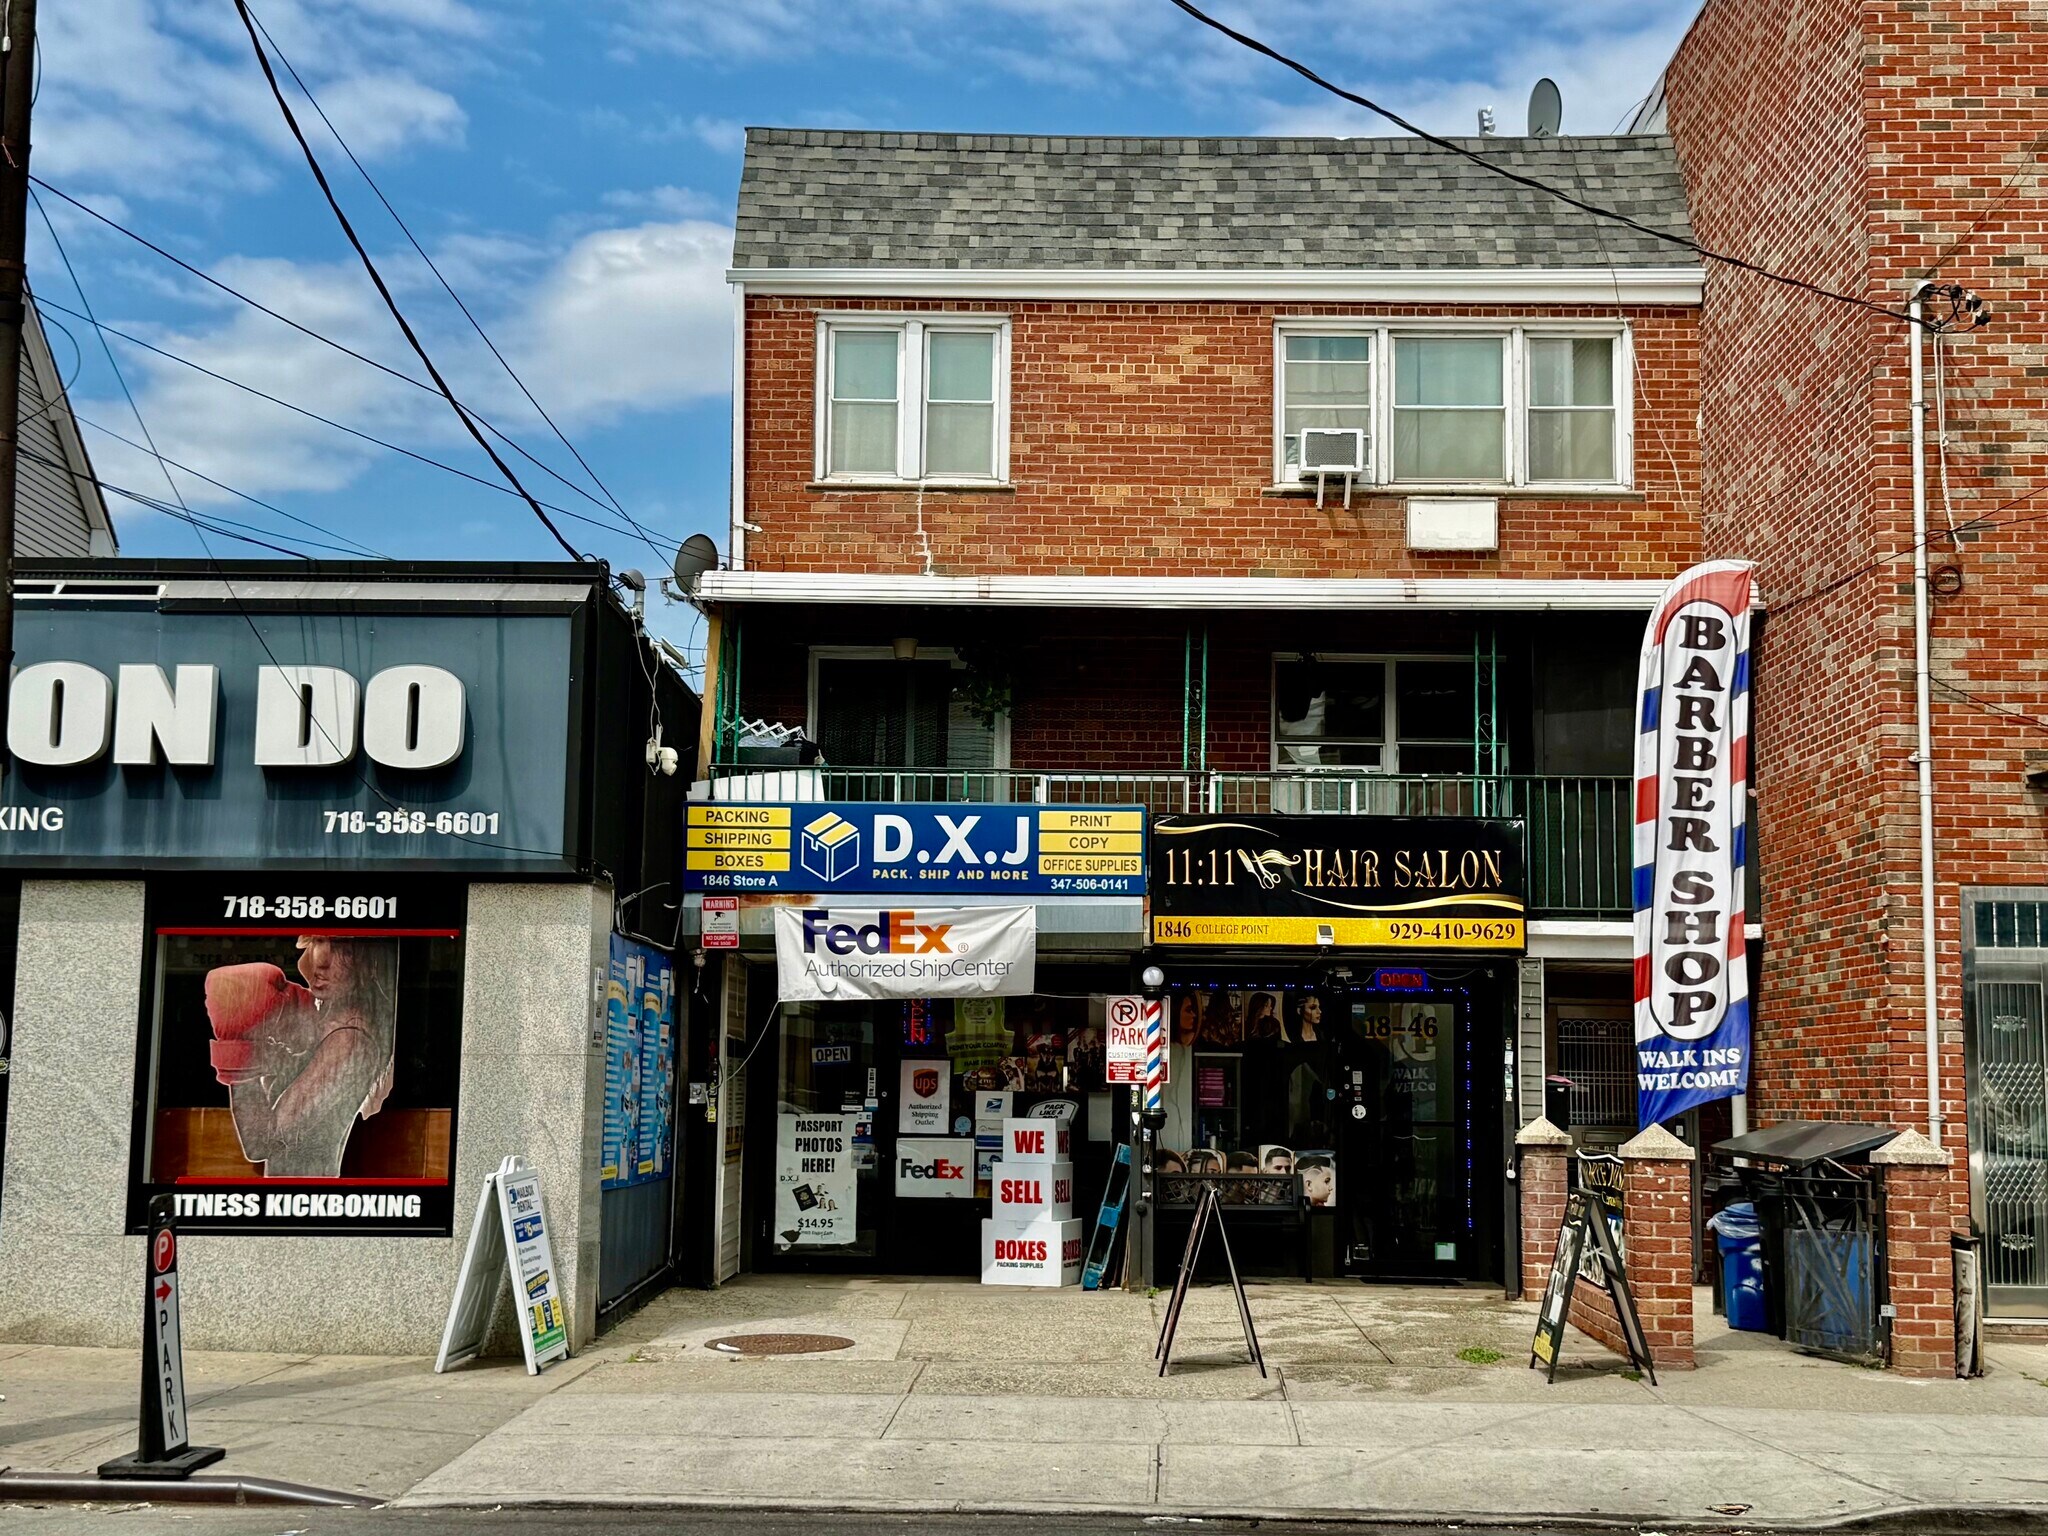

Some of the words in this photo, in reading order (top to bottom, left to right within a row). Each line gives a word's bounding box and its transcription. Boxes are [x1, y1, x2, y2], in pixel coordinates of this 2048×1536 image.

[7, 660, 220, 766] ON
[254, 664, 466, 770] DO
[1667, 615, 1727, 853] BARBER
[324, 811, 499, 835] 718-358-6601
[705, 810, 770, 823] PACKING
[1069, 814, 1112, 827] PRINT
[704, 832, 772, 845] SHIPPING
[873, 814, 1029, 865] D.X.J
[1068, 836, 1109, 849] COPY
[714, 854, 764, 867] BOXES
[1043, 859, 1082, 872] OFFICE
[1084, 858, 1138, 872] SUPPLIES
[1166, 848, 1235, 885] 11:11
[1303, 849, 1381, 887] HAIR
[1395, 850, 1502, 888] SALON
[702, 875, 730, 887] 1846
[733, 874, 765, 887] Store
[769, 876, 778, 887] A
[920, 869, 950, 880] SHIP
[957, 869, 987, 880] AND
[991, 869, 1029, 880] MORE
[1050, 879, 1129, 891] 347-506-0141
[223, 896, 397, 919] 718-358-6601
[705, 900, 734, 908] WARNING
[803, 910, 952, 954] FedEx
[1157, 921, 1191, 937] 1846
[1195, 924, 1239, 935] COLLEGE
[1241, 924, 1269, 935] POINT
[1390, 923, 1516, 940] 929-410-9629
[1663, 869, 1721, 1027] SHOP
[805, 958, 907, 979] Authorized
[909, 957, 1014, 982] ShipCenter
[1381, 973, 1422, 986] OPEN
[1112, 1028, 1166, 1045] PARKG
[816, 1048, 848, 1061] OPEN
[1639, 1050, 1697, 1069] WALK
[1702, 1049, 1741, 1066] INS
[915, 1077, 937, 1094] ups
[795, 1121, 843, 1132] PASSPORT
[795, 1137, 842, 1152] PHOTOS
[1014, 1130, 1045, 1153] WE
[1057, 1130, 1069, 1153] WE
[802, 1158, 835, 1172] HERE!
[901, 1158, 964, 1179] FedEx
[1001, 1180, 1042, 1204] SELL
[1054, 1179, 1070, 1203] SELL
[175, 1193, 260, 1217] ITNESS
[265, 1194, 421, 1217] KICKBOXING
[798, 1217, 834, 1228] $14.95
[995, 1239, 1047, 1261] BOXES
[160, 1310, 179, 1441] PARK
